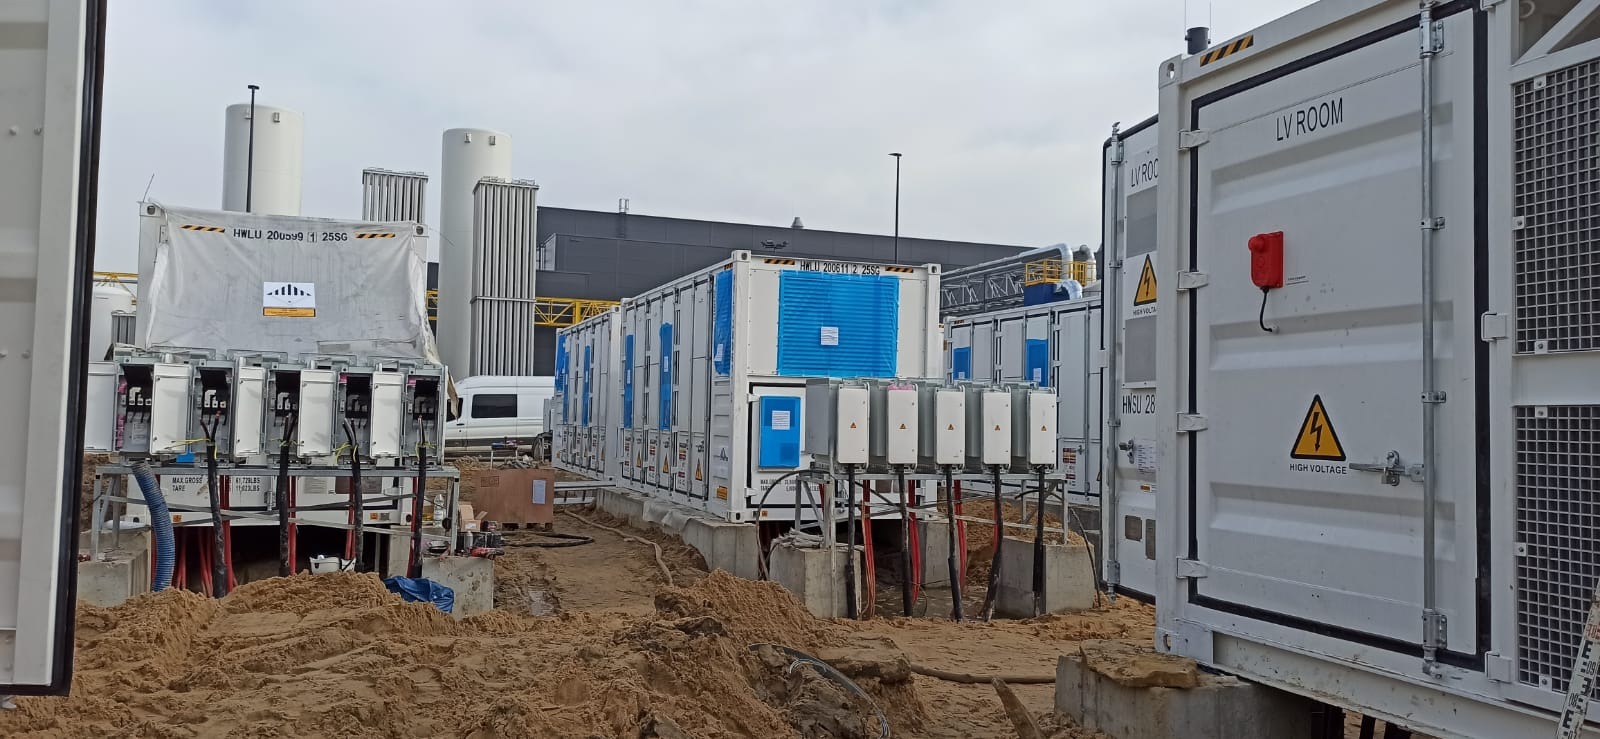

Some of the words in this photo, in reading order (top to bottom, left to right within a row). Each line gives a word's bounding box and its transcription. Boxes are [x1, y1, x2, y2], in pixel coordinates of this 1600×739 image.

[1276, 112, 1293, 141] LV
[1296, 96, 1343, 136] ROOM
[1131, 165, 1141, 187] LV
[233, 228, 262, 239] HWLU
[266, 230, 304, 241] 200599
[321, 232, 348, 242] 25SG
[1289, 463, 1309, 472] HIGH
[1309, 464, 1348, 475] VOLTAGE
